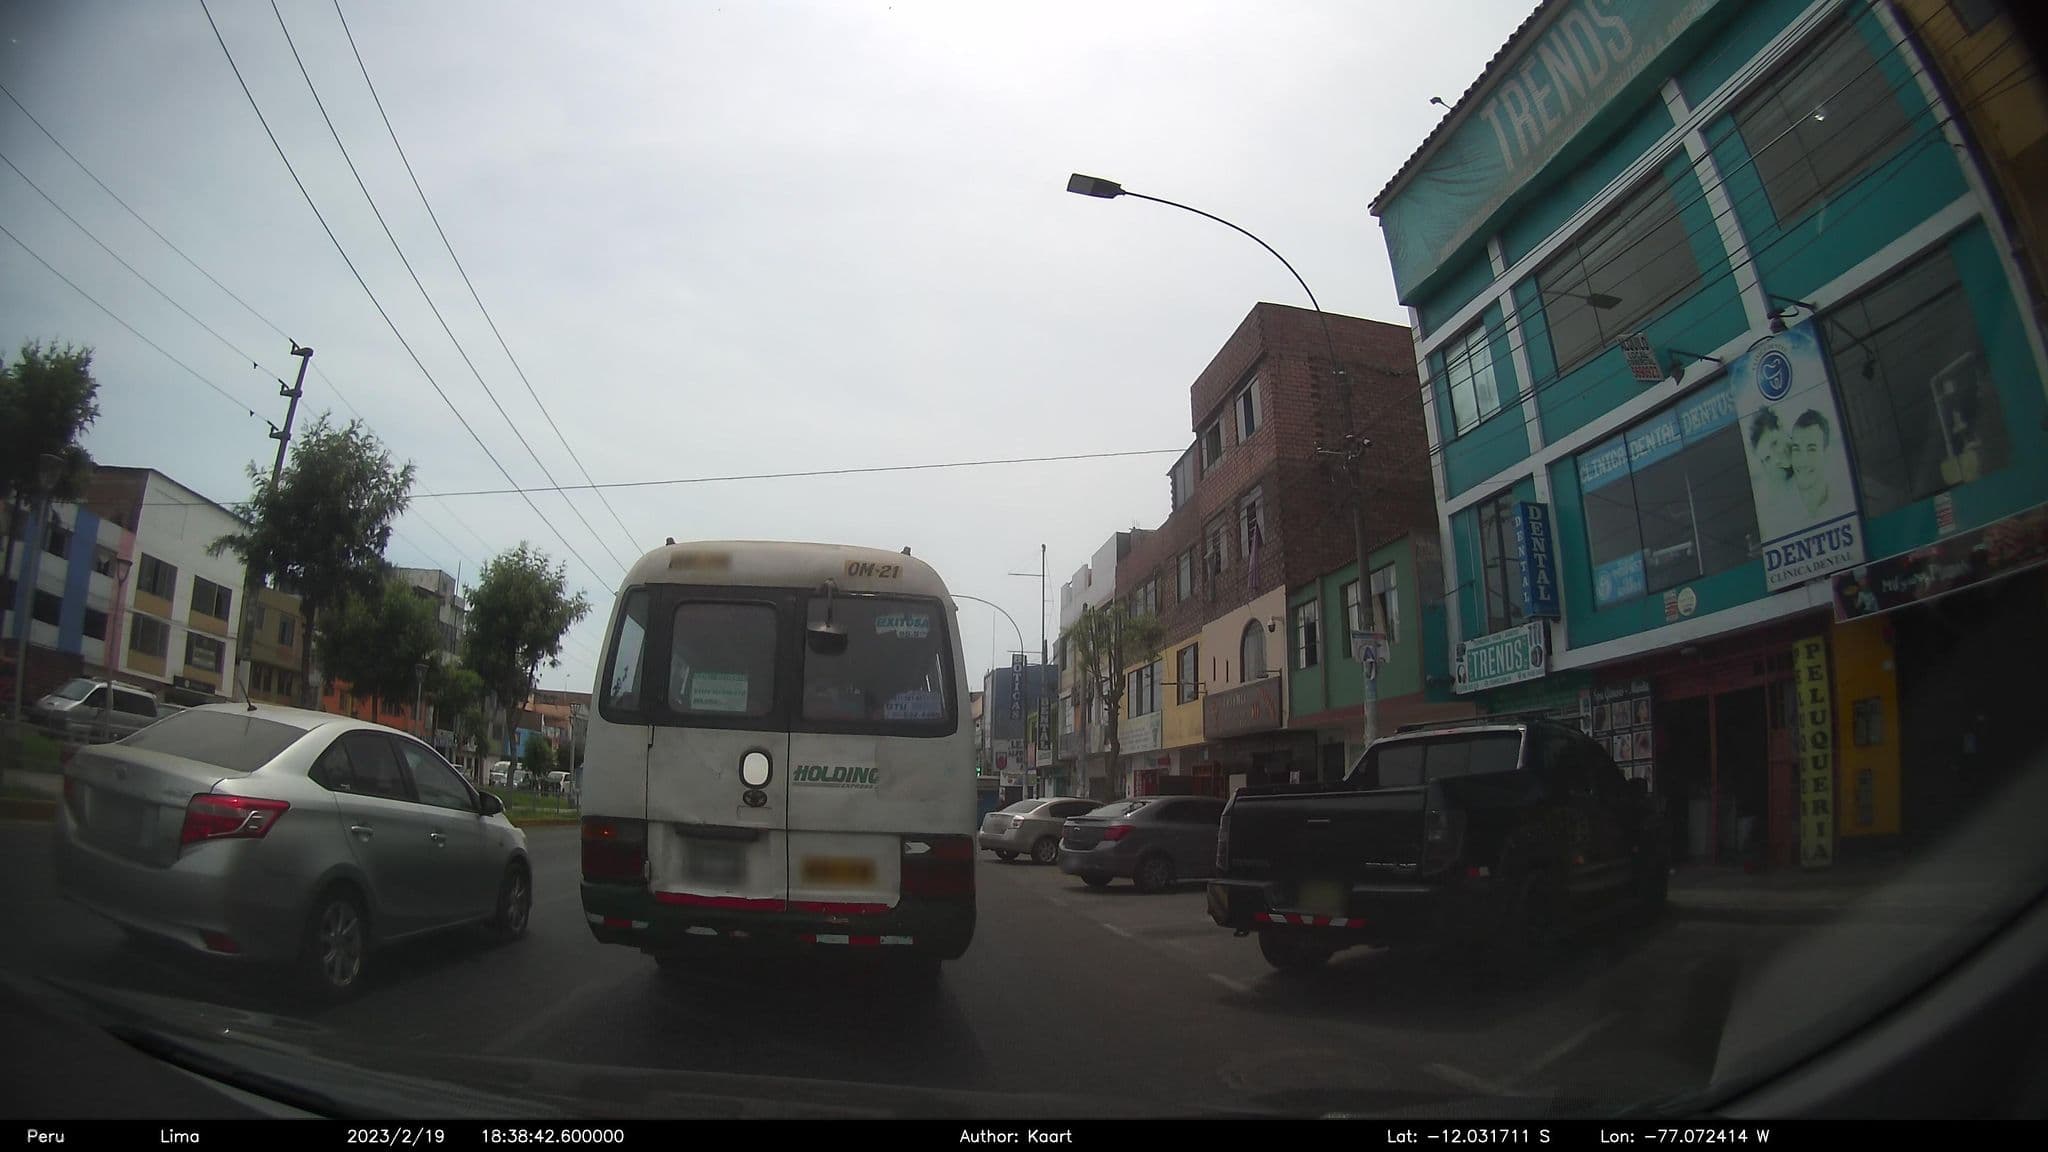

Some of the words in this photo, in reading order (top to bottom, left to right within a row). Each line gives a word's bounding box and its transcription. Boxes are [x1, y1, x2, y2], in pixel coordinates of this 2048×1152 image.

[1479, 0, 1634, 171] TRENDS
[1631, 421, 1682, 459] DENTAL
[1683, 391, 1737, 433] DENTUS
[1514, 515, 1529, 603] DENTAL
[1527, 505, 1551, 601] DENTAL
[1766, 523, 1853, 571] DENTUS
[1770, 565, 1812, 584] CLINICA
[1812, 552, 1851, 571] DENTAL
[1011, 655, 1022, 720] BOTICAS
[1472, 639, 1523, 680] TRENDS
[1804, 642, 1830, 859] PELUQUERIA
